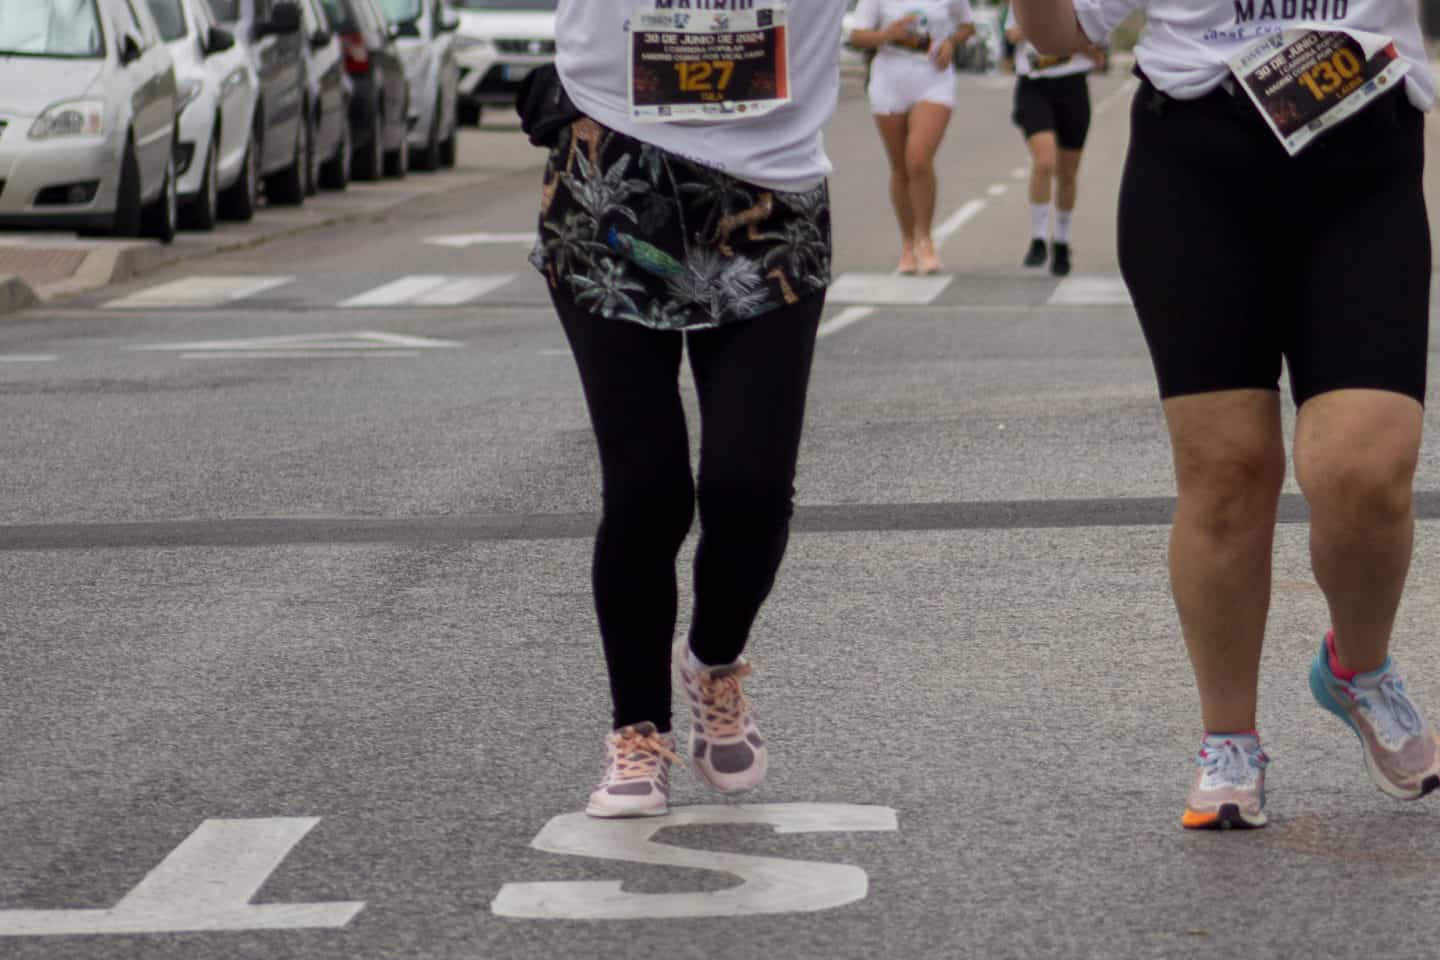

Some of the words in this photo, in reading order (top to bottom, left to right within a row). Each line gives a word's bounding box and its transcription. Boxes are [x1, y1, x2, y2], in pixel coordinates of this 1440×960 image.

[661, 33, 678, 44] DE
[680, 33, 714, 45] JUNIO
[1254, 64, 1272, 81] 30
[1270, 54, 1287, 69] DE
[1289, 34, 1319, 58] JUNIO
[674, 61, 735, 91] 127
[1298, 47, 1361, 102] 130
